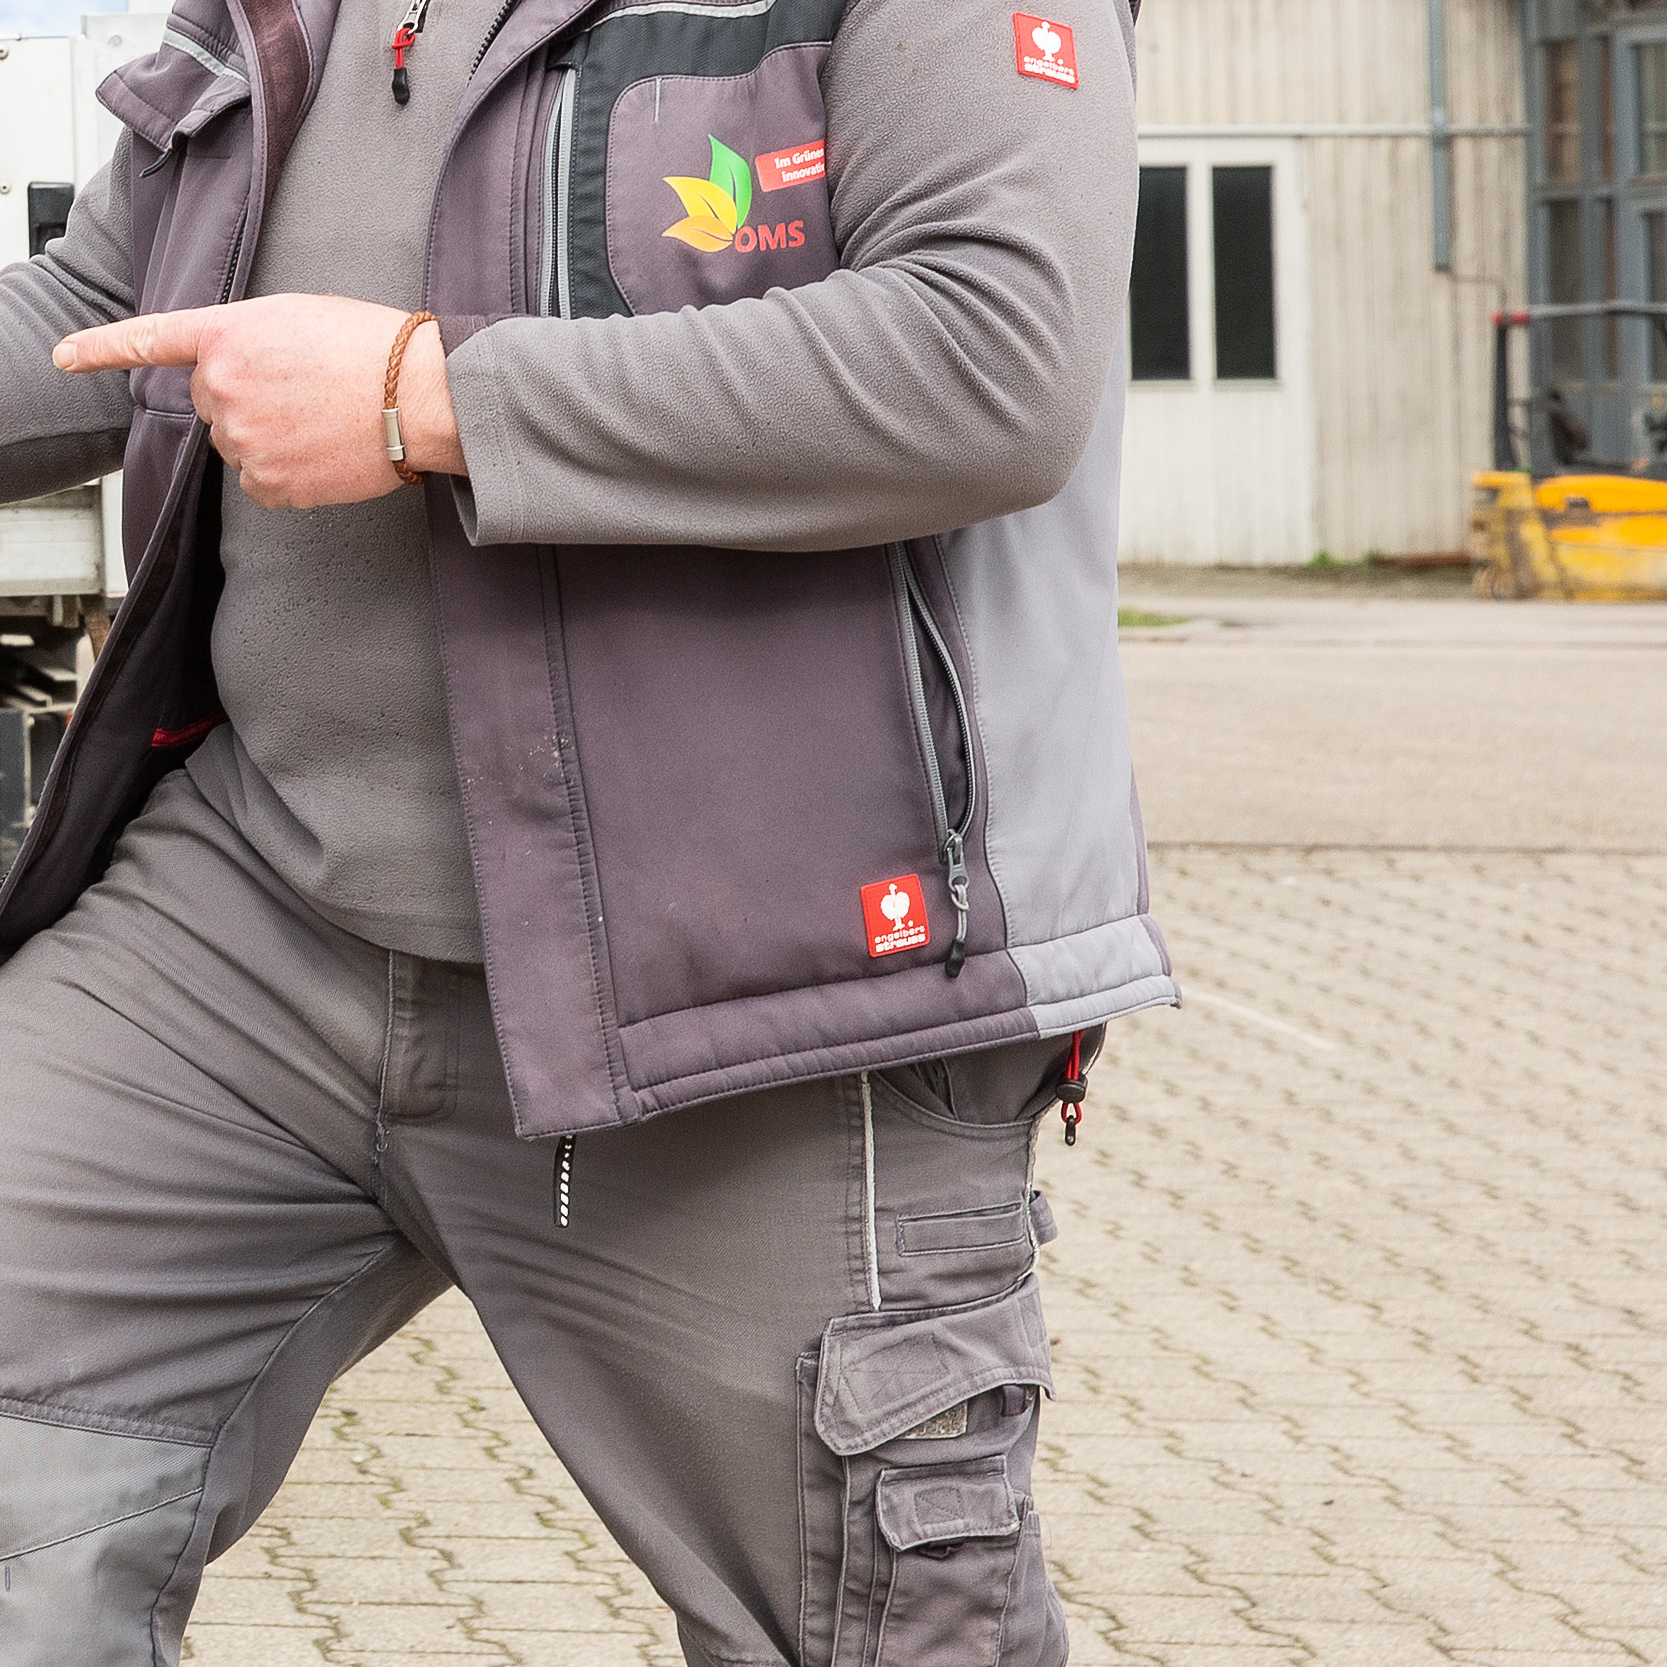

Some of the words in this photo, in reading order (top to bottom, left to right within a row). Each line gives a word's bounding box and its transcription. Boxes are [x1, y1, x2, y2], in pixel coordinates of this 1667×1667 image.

[774, 157, 791, 169] Im
[792, 148, 824, 165] Grüne
[734, 220, 806, 253] OMS
